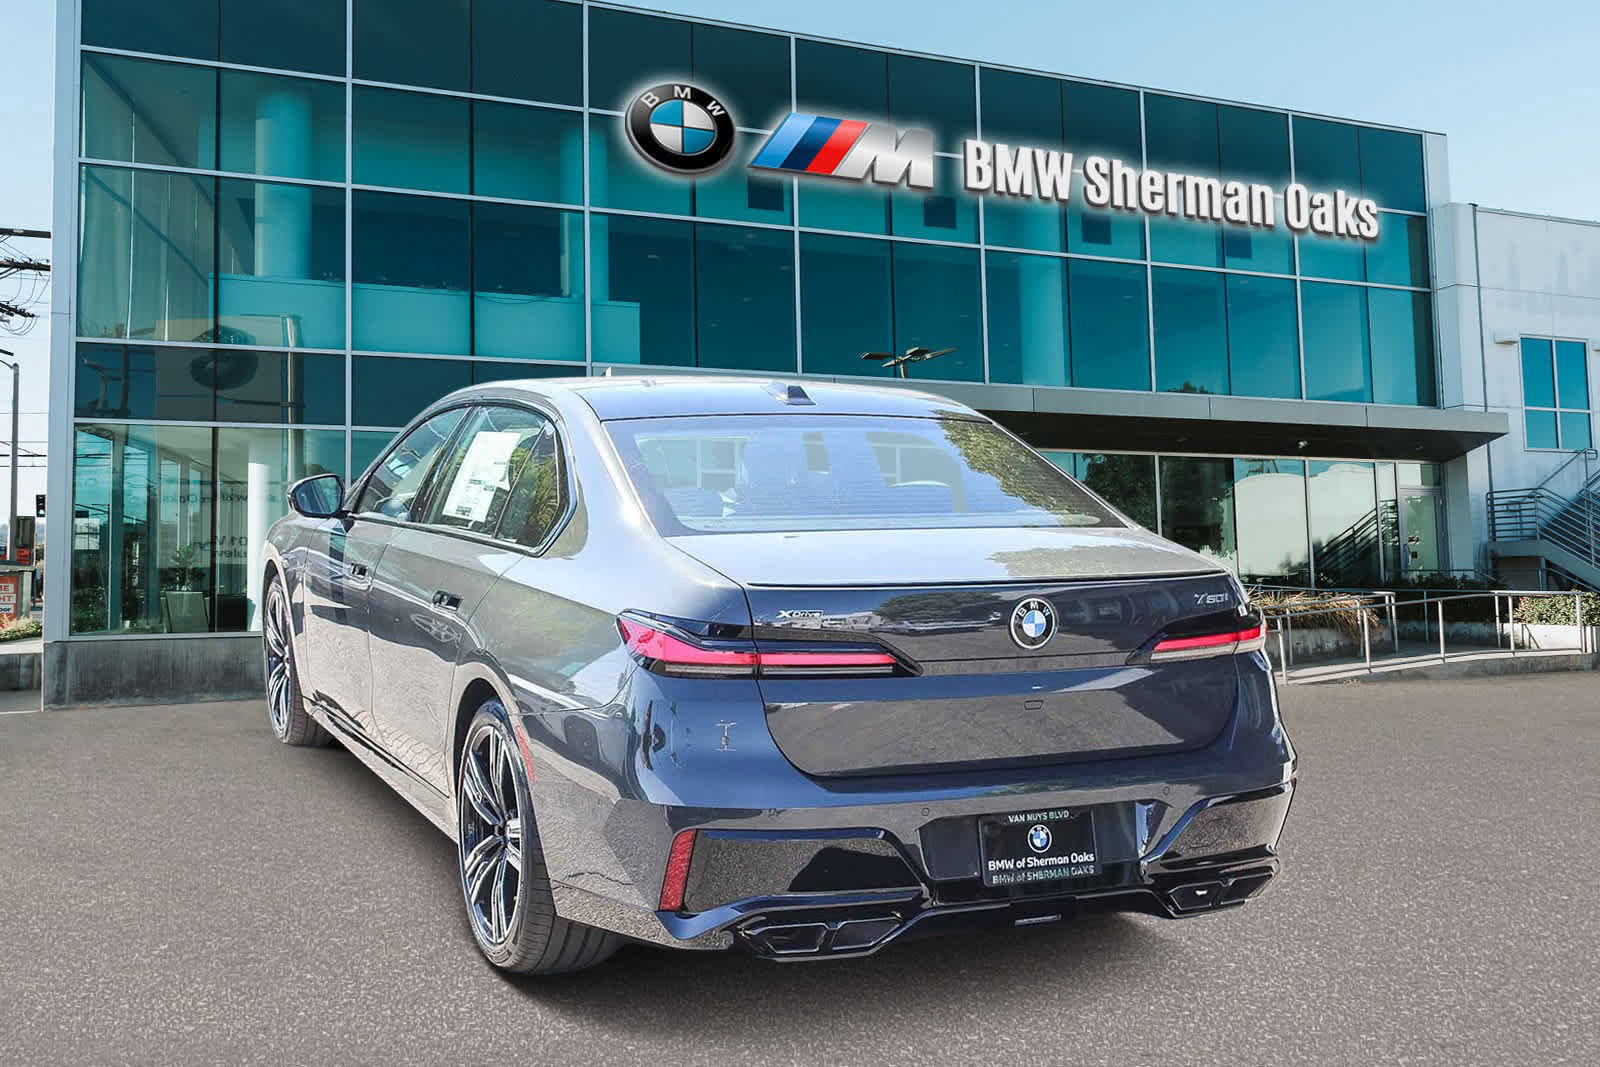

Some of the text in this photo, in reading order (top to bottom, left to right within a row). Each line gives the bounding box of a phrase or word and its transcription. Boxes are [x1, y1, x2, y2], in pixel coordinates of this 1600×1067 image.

[641, 84, 725, 117] BMW
[964, 138, 1380, 242] BMW Sherman Oaks
[1008, 814, 1026, 823] VAN
[1027, 812, 1047, 821] NUYS
[988, 852, 1095, 872] BMW of Sherman Oaks
[992, 874, 1014, 885] BMW
[1027, 869, 1070, 881] SHERMAN
[1071, 865, 1095, 876] OAKS
